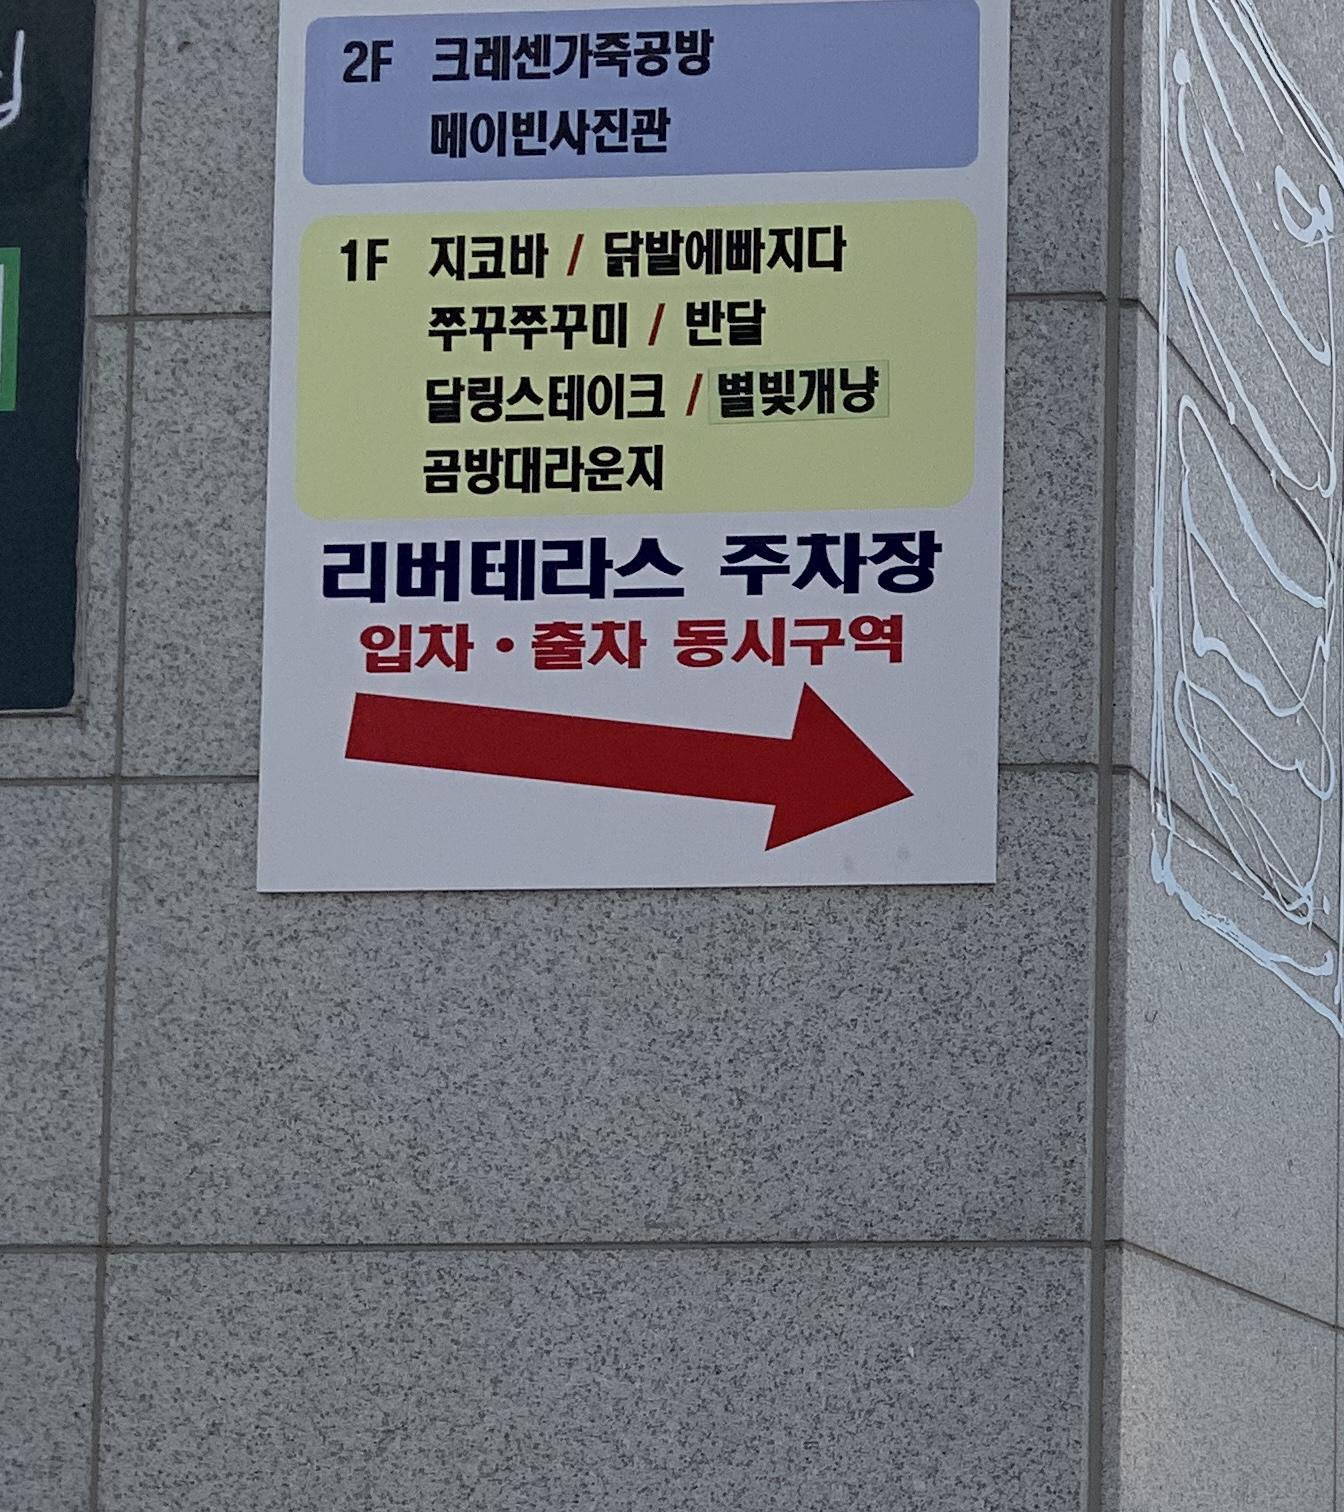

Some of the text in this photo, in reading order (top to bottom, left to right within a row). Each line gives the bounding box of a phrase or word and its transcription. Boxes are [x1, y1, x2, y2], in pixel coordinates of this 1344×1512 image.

[343, 29, 715, 84] 2F 크레센가죽공방
[431, 107, 672, 160] 메이빈사진관
[340, 239, 390, 283] 1F
[429, 232, 549, 282] 지코바
[604, 225, 848, 279] 닭발에빠지다
[428, 302, 629, 353] 쭈꾸쭈꾸미
[686, 299, 767, 348] 반달
[426, 373, 667, 425] 달링스테이크
[718, 366, 881, 420] 별빛개냥
[423, 445, 665, 496] 곰방대라운지
[322, 531, 944, 605] 리버테라스 주차장
[360, 623, 475, 675] 입차
[533, 621, 648, 672] 출차
[675, 614, 905, 669] 동시구역
